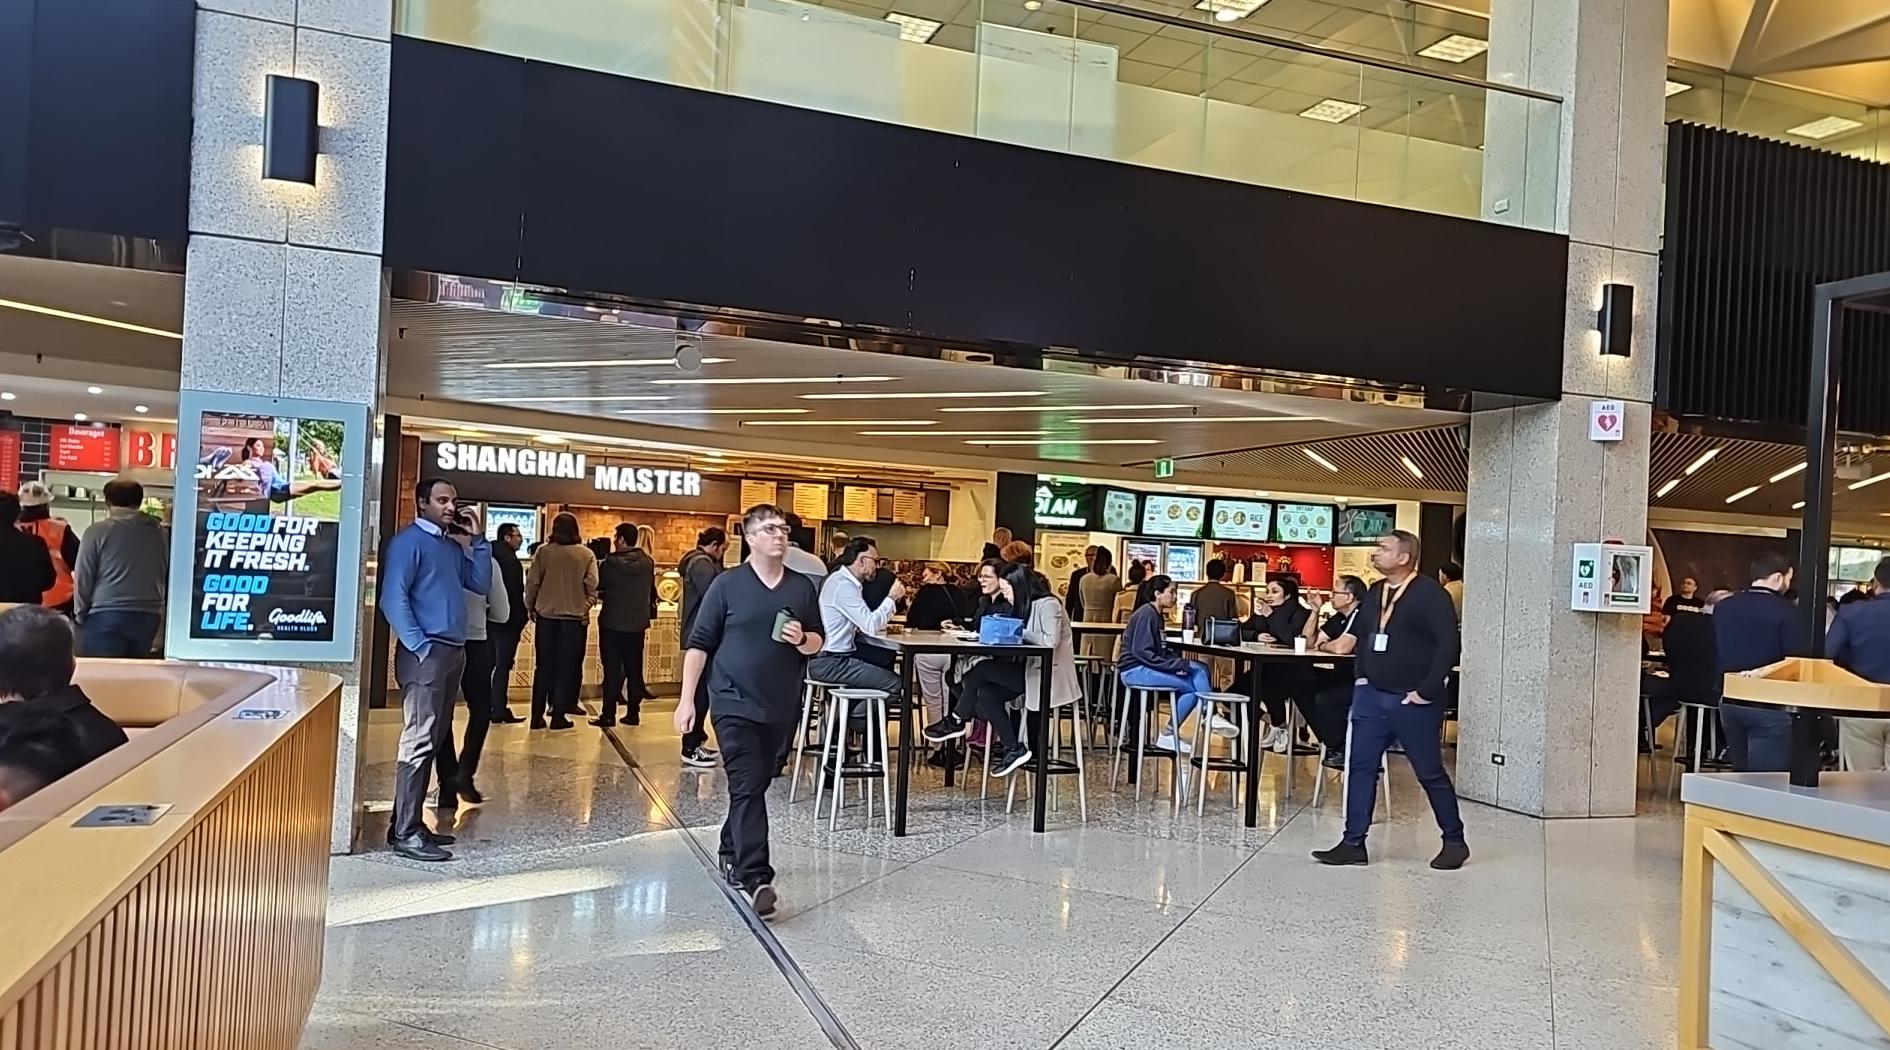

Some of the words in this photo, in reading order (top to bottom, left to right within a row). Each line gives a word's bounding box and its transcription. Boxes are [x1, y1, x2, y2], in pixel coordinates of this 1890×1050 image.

[68, 427, 105, 438] Beverages
[437, 443, 586, 479] SHANGHAI
[594, 465, 700, 496] MASTER
[1051, 498, 1078, 515] AN
[206, 512, 272, 532] GOOD
[272, 516, 320, 535] FOR
[1250, 513, 1264, 523] RICE
[1367, 519, 1384, 532] AN
[205, 531, 306, 552] KEEPING
[204, 550, 228, 568] IT
[230, 550, 310, 571] FRESH.
[203, 574, 269, 594] GOOD
[202, 593, 250, 611] FOR
[201, 612, 254, 630] LIFE.
